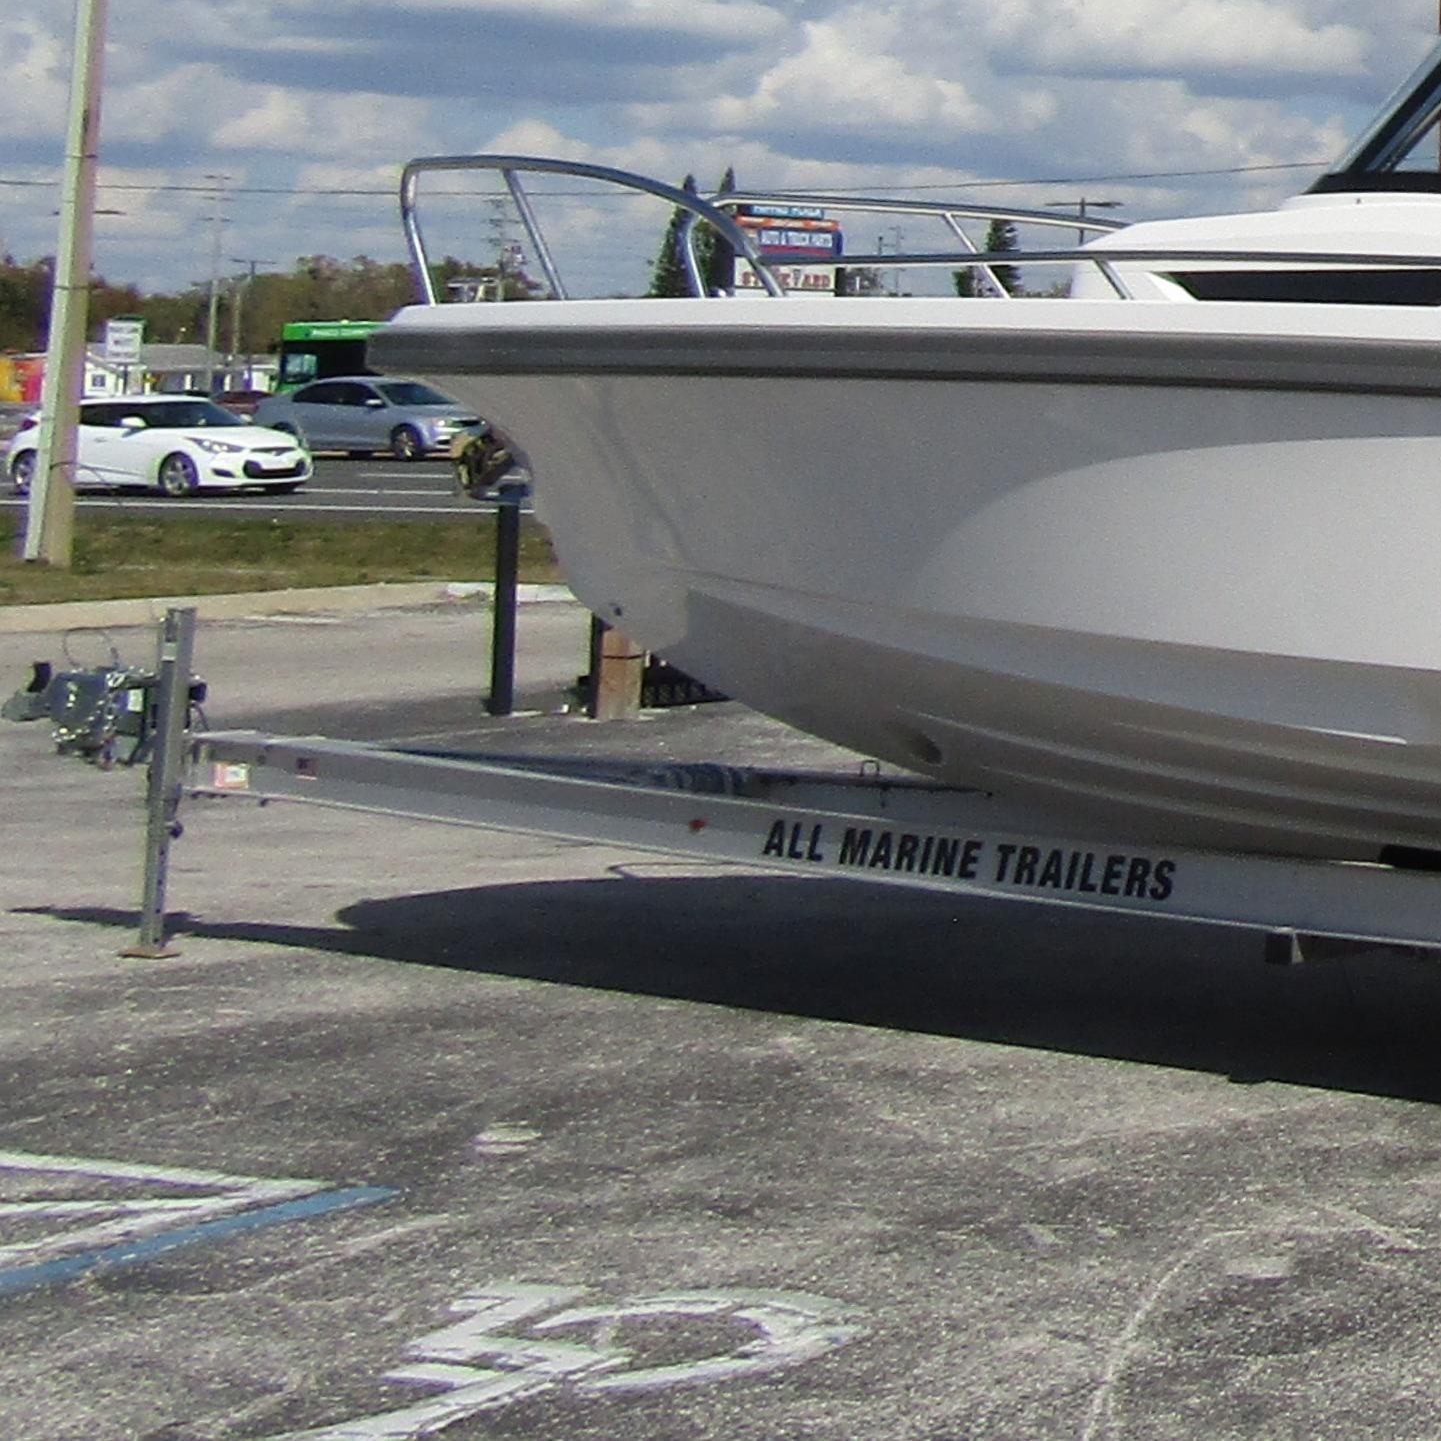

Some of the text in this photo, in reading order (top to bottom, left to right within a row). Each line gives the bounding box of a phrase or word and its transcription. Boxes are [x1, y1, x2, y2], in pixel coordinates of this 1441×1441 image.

[763, 818, 1177, 901] ALL MARINE TRAILERS
